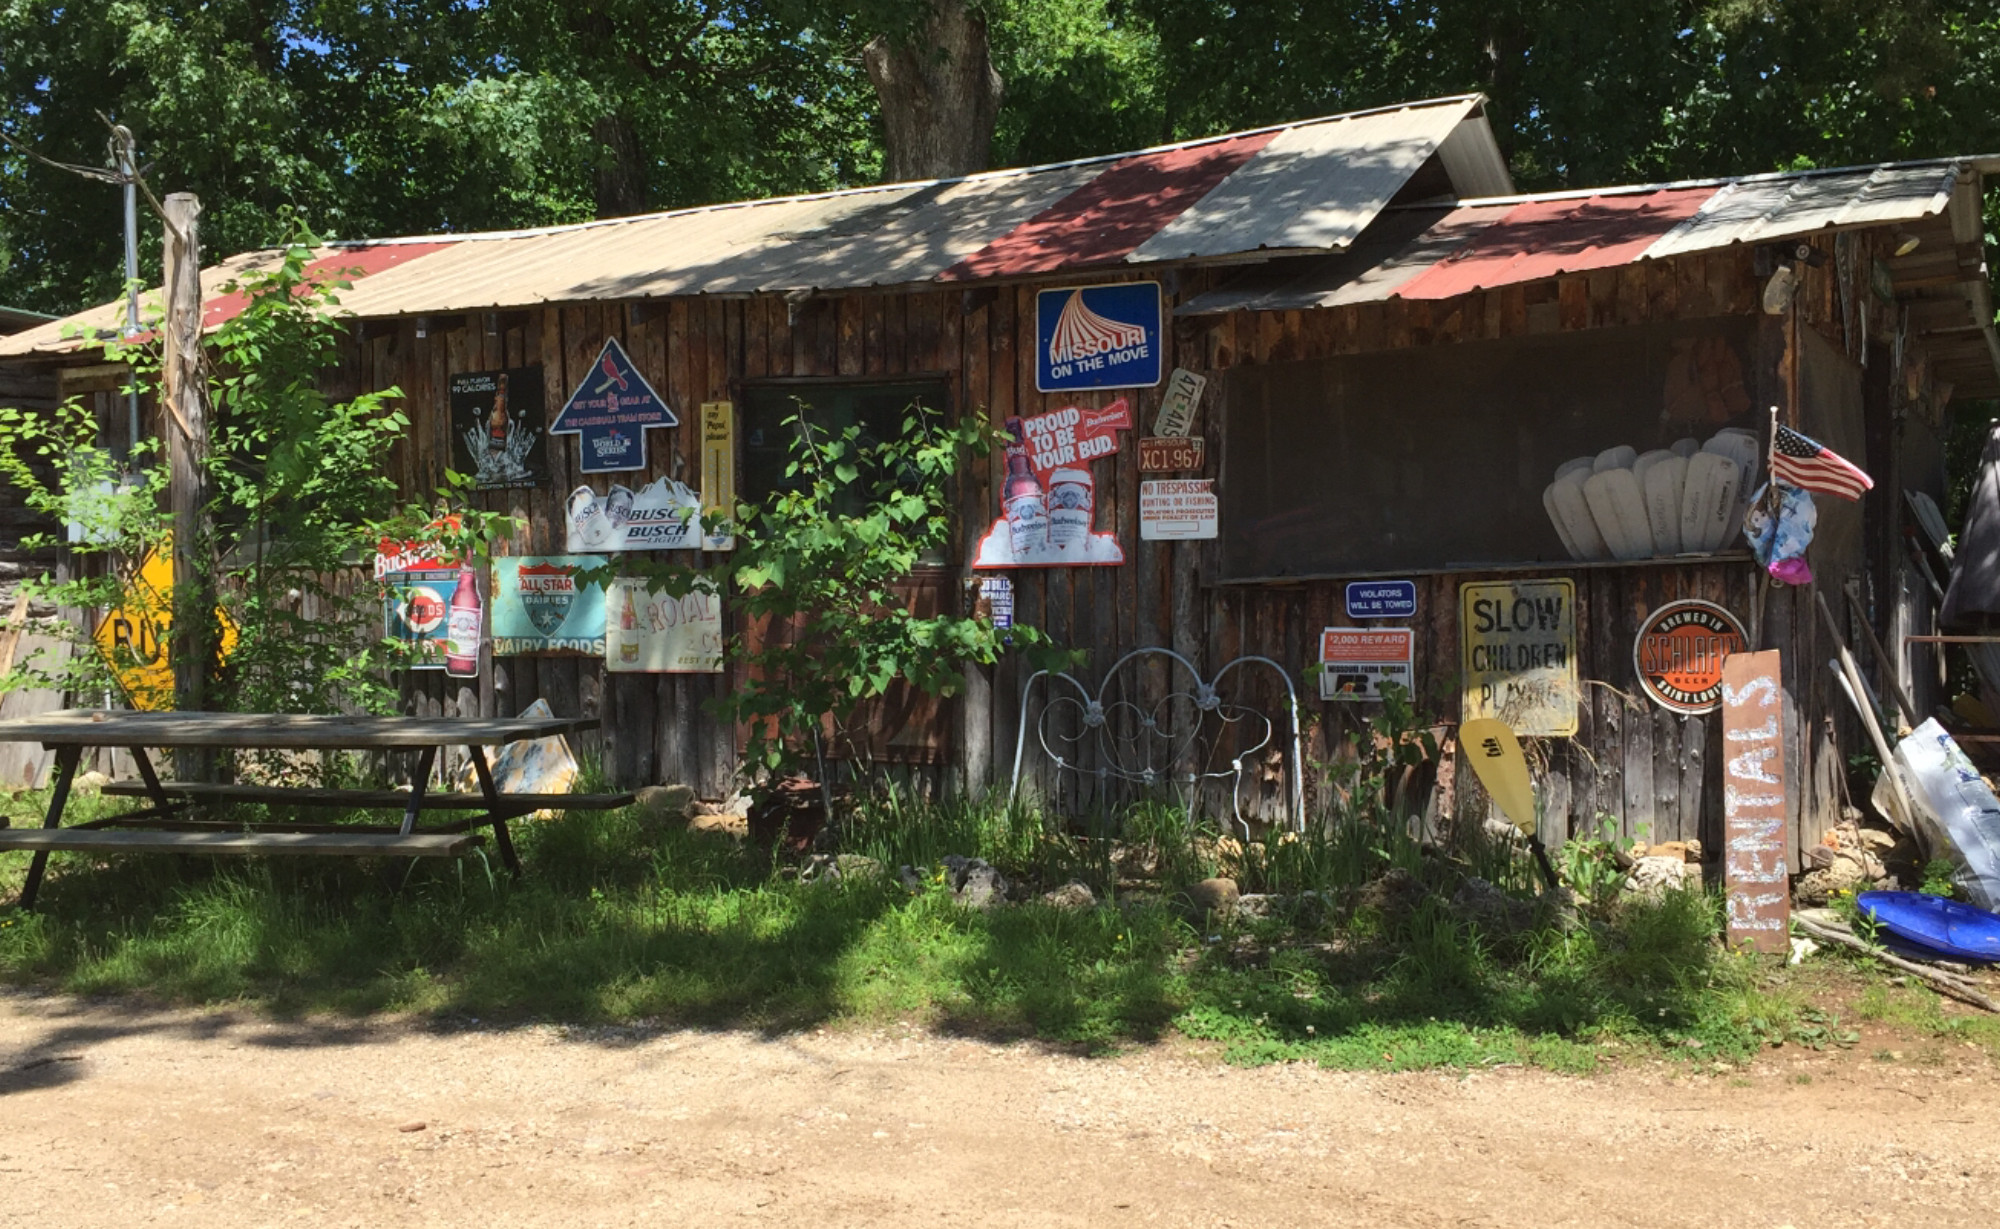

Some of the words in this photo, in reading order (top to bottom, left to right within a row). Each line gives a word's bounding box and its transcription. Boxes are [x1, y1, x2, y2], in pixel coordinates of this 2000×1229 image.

[1049, 326, 1147, 365] MISSOURI
[1051, 364, 1072, 379] ON
[1076, 356, 1105, 373] THE
[1108, 345, 1149, 366] MOVE
[1024, 408, 1080, 437] PROUD
[1031, 432, 1054, 453] TO
[1055, 427, 1076, 447] BE
[1031, 445, 1077, 471] YOUR
[1142, 482, 1154, 495] NO
[1185, 496, 1215, 506] FISHING
[629, 508, 682, 521] BUSC
[627, 525, 690, 538] BUSCH
[648, 535, 685, 544] LIGHT
[520, 579, 539, 591] ALL
[543, 578, 572, 591] STAR
[526, 595, 569, 605] DAIRIES
[1360, 589, 1402, 599] VIOLATORS
[1350, 602, 1369, 610] WILL
[1371, 601, 1382, 609] BE
[1385, 600, 1413, 609] TOWED
[1473, 597, 1563, 634] SLOW
[1660, 612, 1708, 632] BREWED
[1709, 619, 1724, 632] IN
[493, 638, 542, 655] DAIRY
[547, 638, 606, 655] FOODS
[1360, 634, 1407, 644] REWARD
[1472, 642, 1567, 672] CHILDREN
[1656, 680, 1691, 703] SAINT
[1722, 675, 1788, 932] RENTALS
